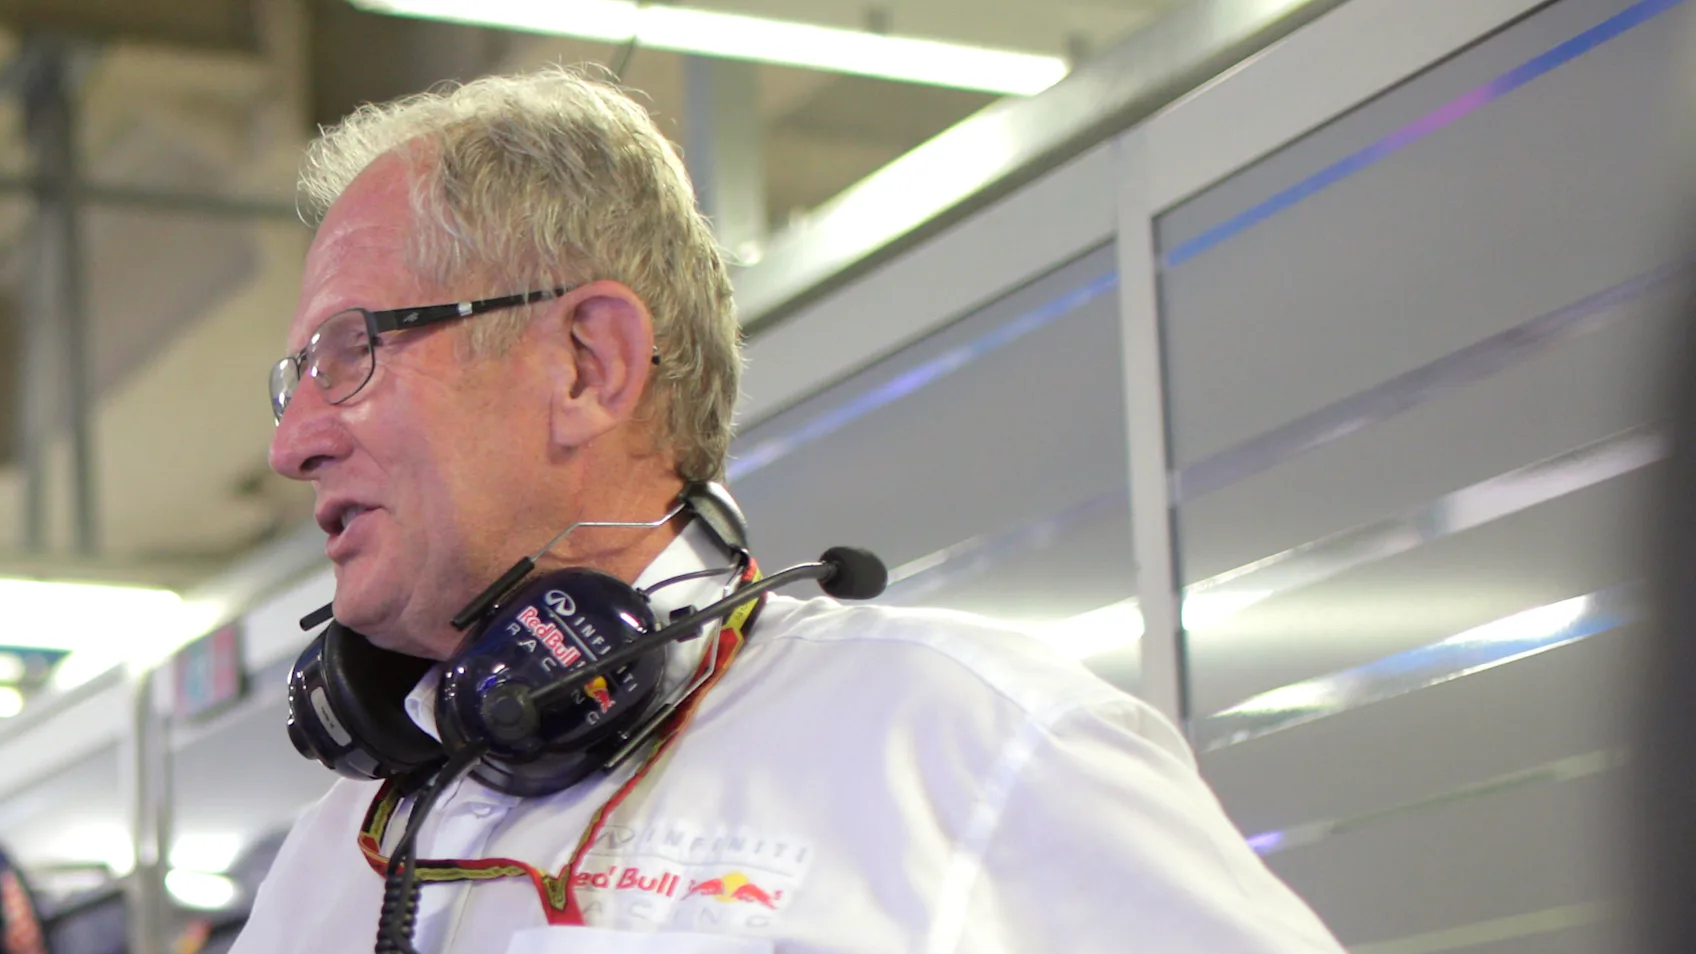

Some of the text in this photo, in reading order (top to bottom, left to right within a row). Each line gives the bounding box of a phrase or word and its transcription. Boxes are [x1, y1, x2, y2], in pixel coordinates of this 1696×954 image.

[543, 628, 582, 668] Bull
[573, 617, 638, 692] INFIITI
[506, 622, 600, 725] RACNG
[575, 866, 680, 897] ed Bull
[582, 901, 772, 928] ACING
